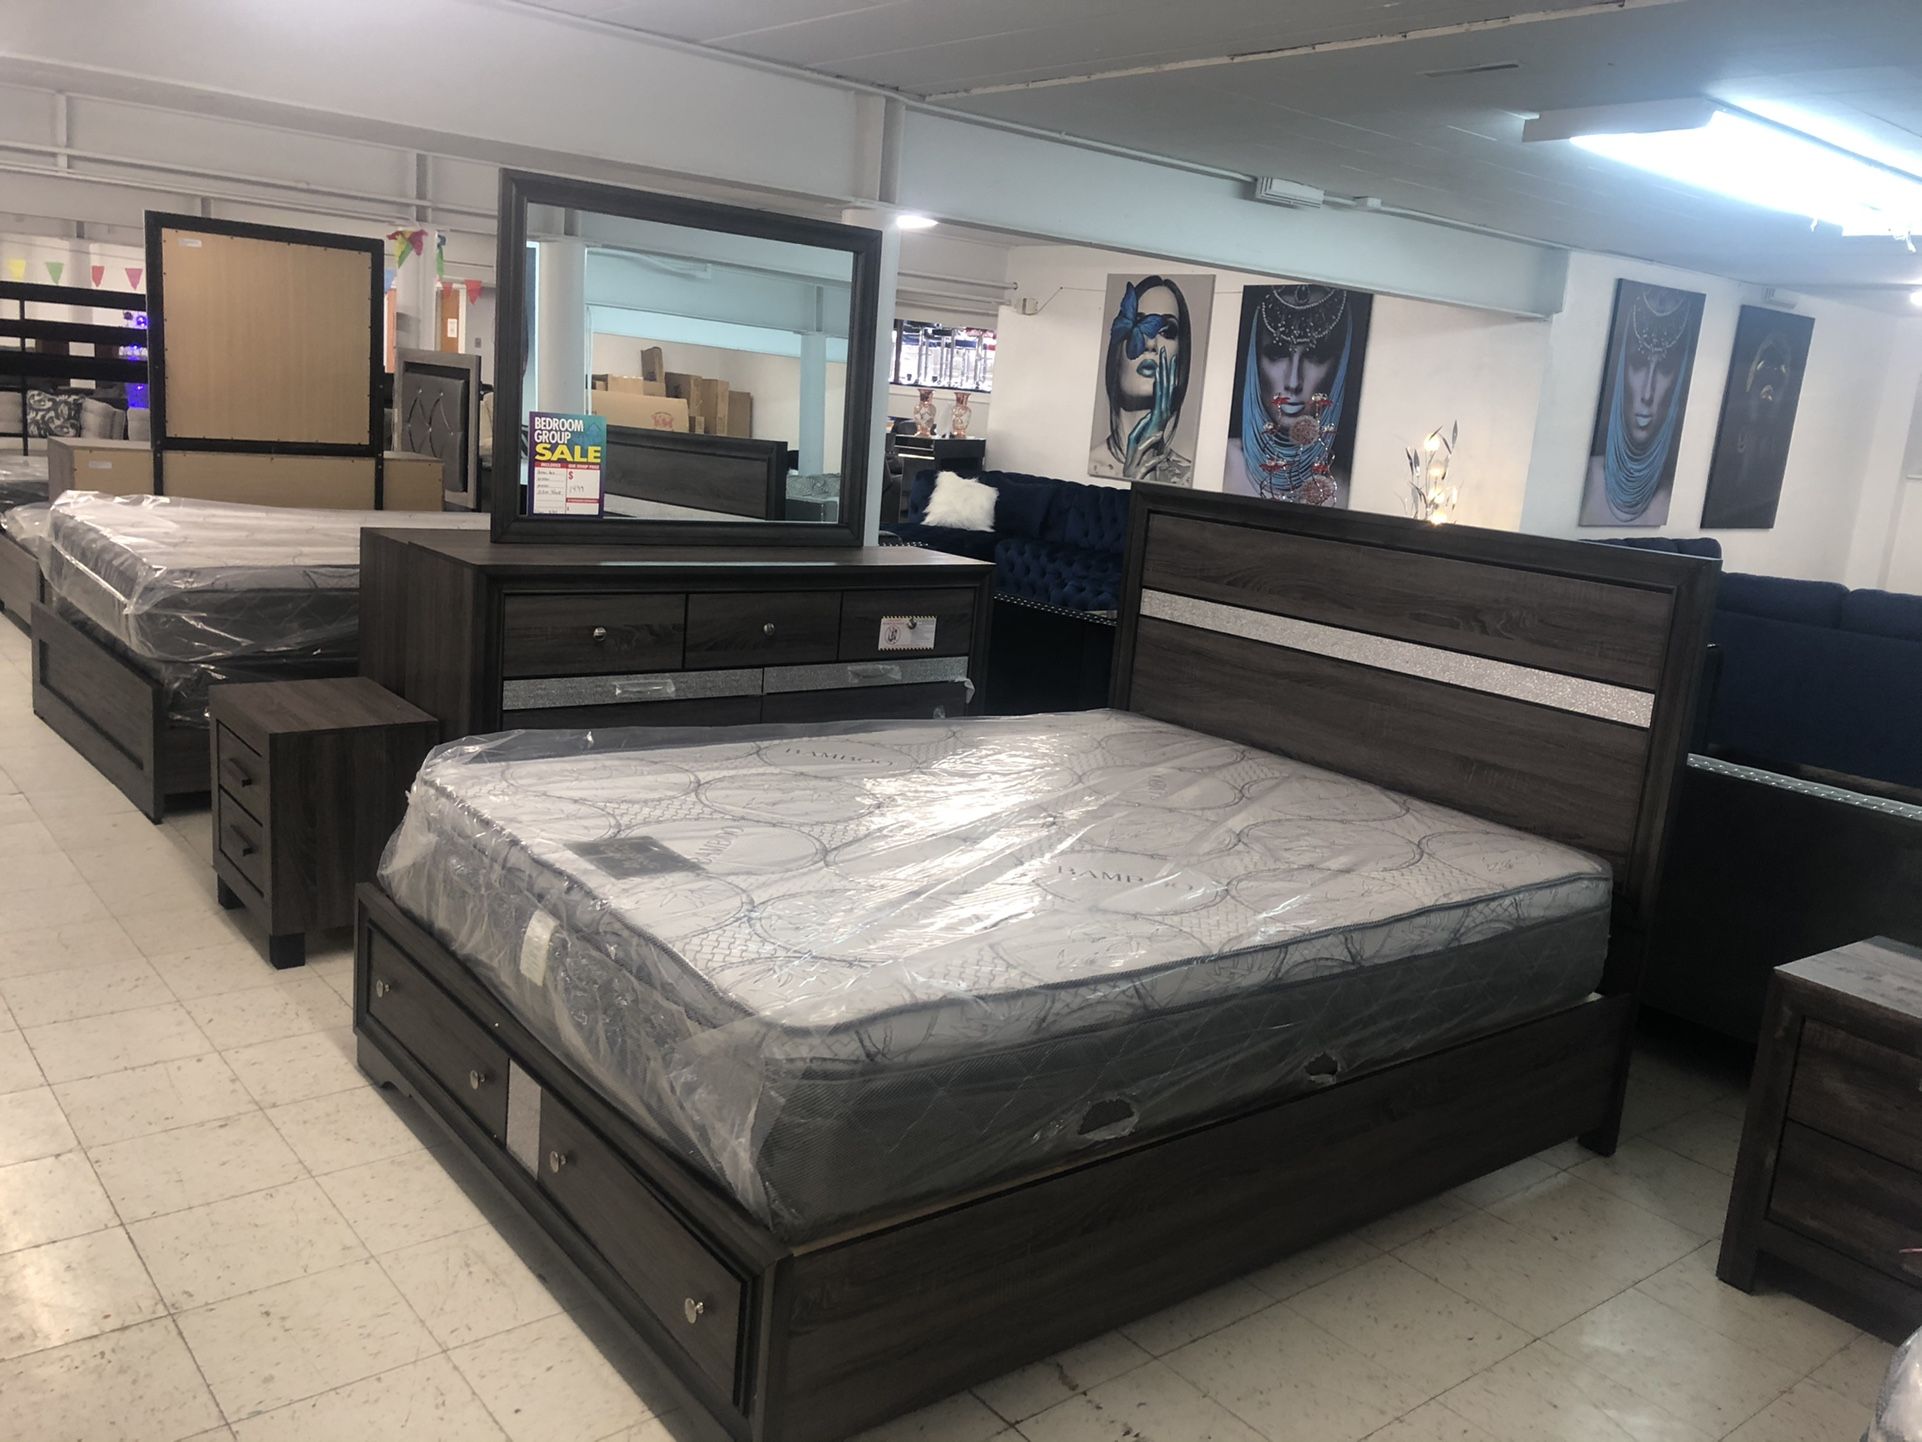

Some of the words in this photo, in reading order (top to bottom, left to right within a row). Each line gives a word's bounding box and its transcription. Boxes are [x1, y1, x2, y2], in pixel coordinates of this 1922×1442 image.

[534, 417, 584, 432] BEDROOM
[534, 430, 572, 444] GROUP
[534, 443, 602, 463] SALE
[568, 471, 574, 480] $
